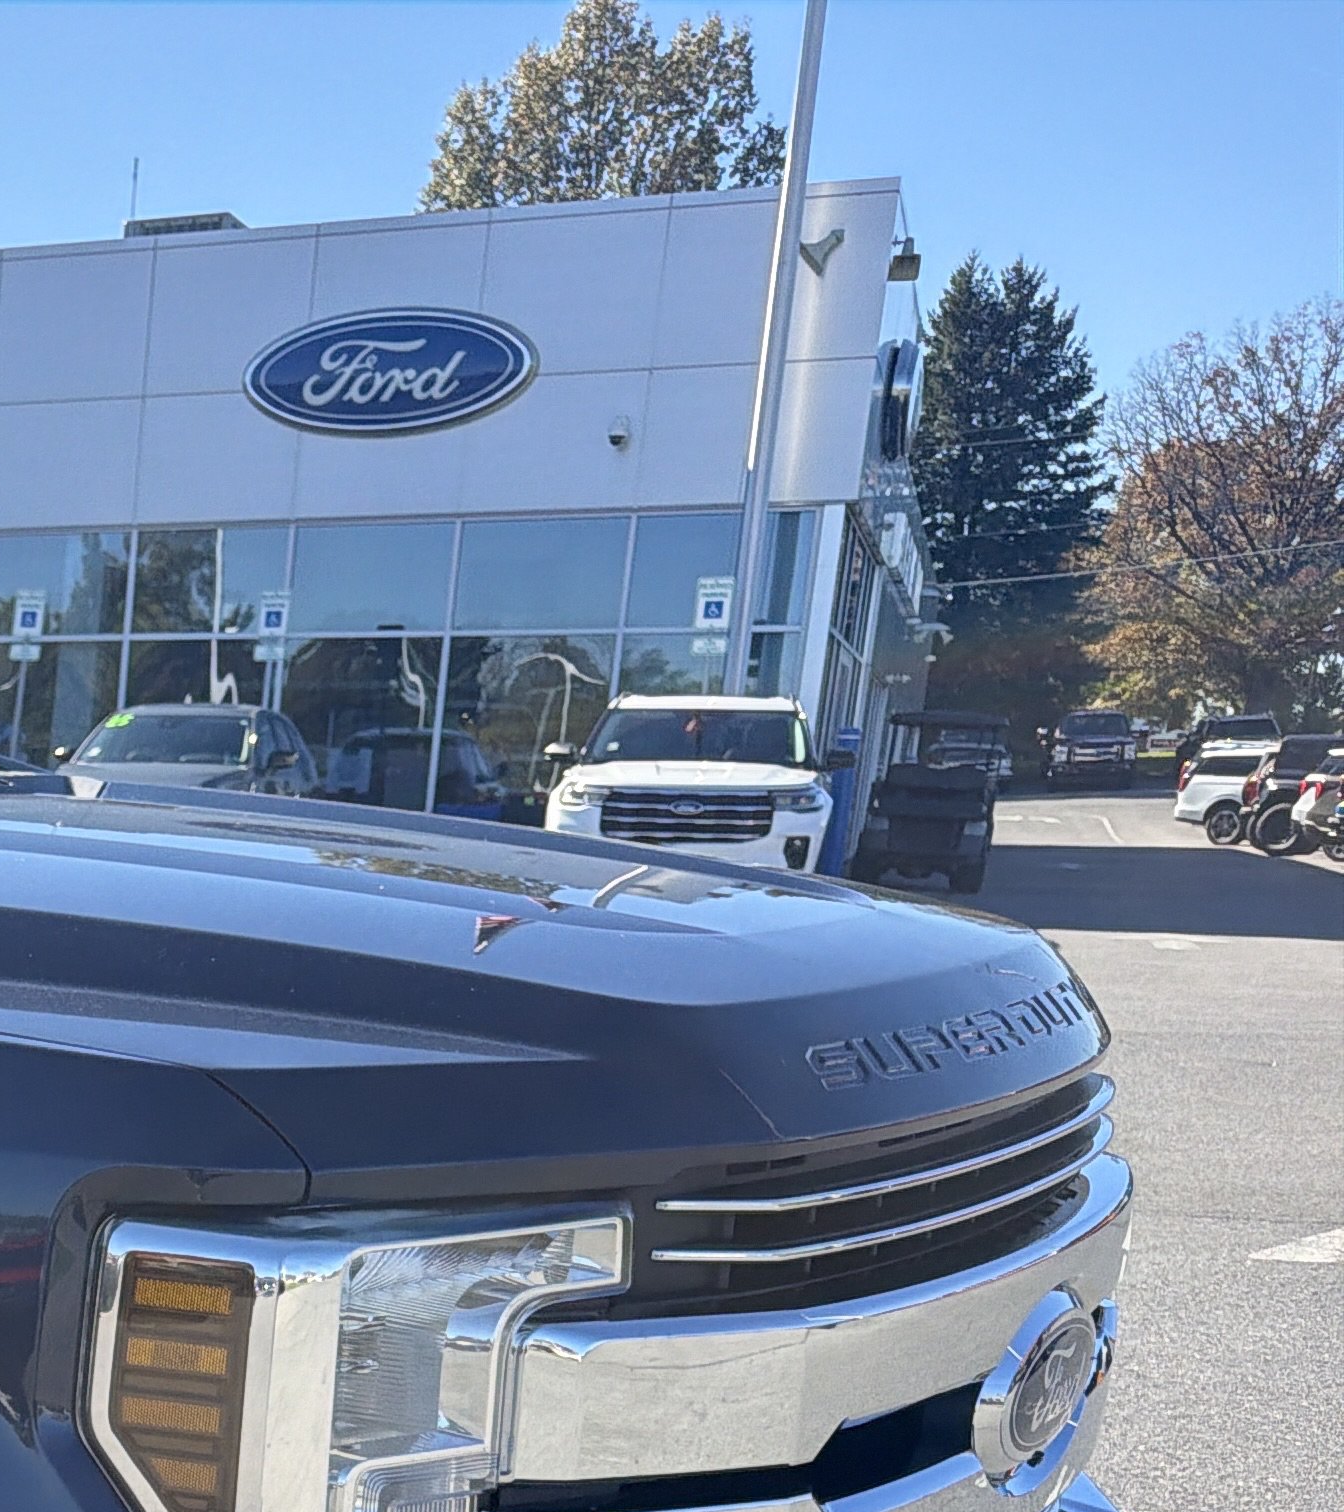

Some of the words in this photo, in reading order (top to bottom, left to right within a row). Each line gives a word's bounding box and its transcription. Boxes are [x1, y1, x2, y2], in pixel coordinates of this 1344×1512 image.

[302, 338, 466, 406] Ford
[805, 1009, 1027, 1092] SUPER
[1024, 1342, 1088, 1432] Ford
